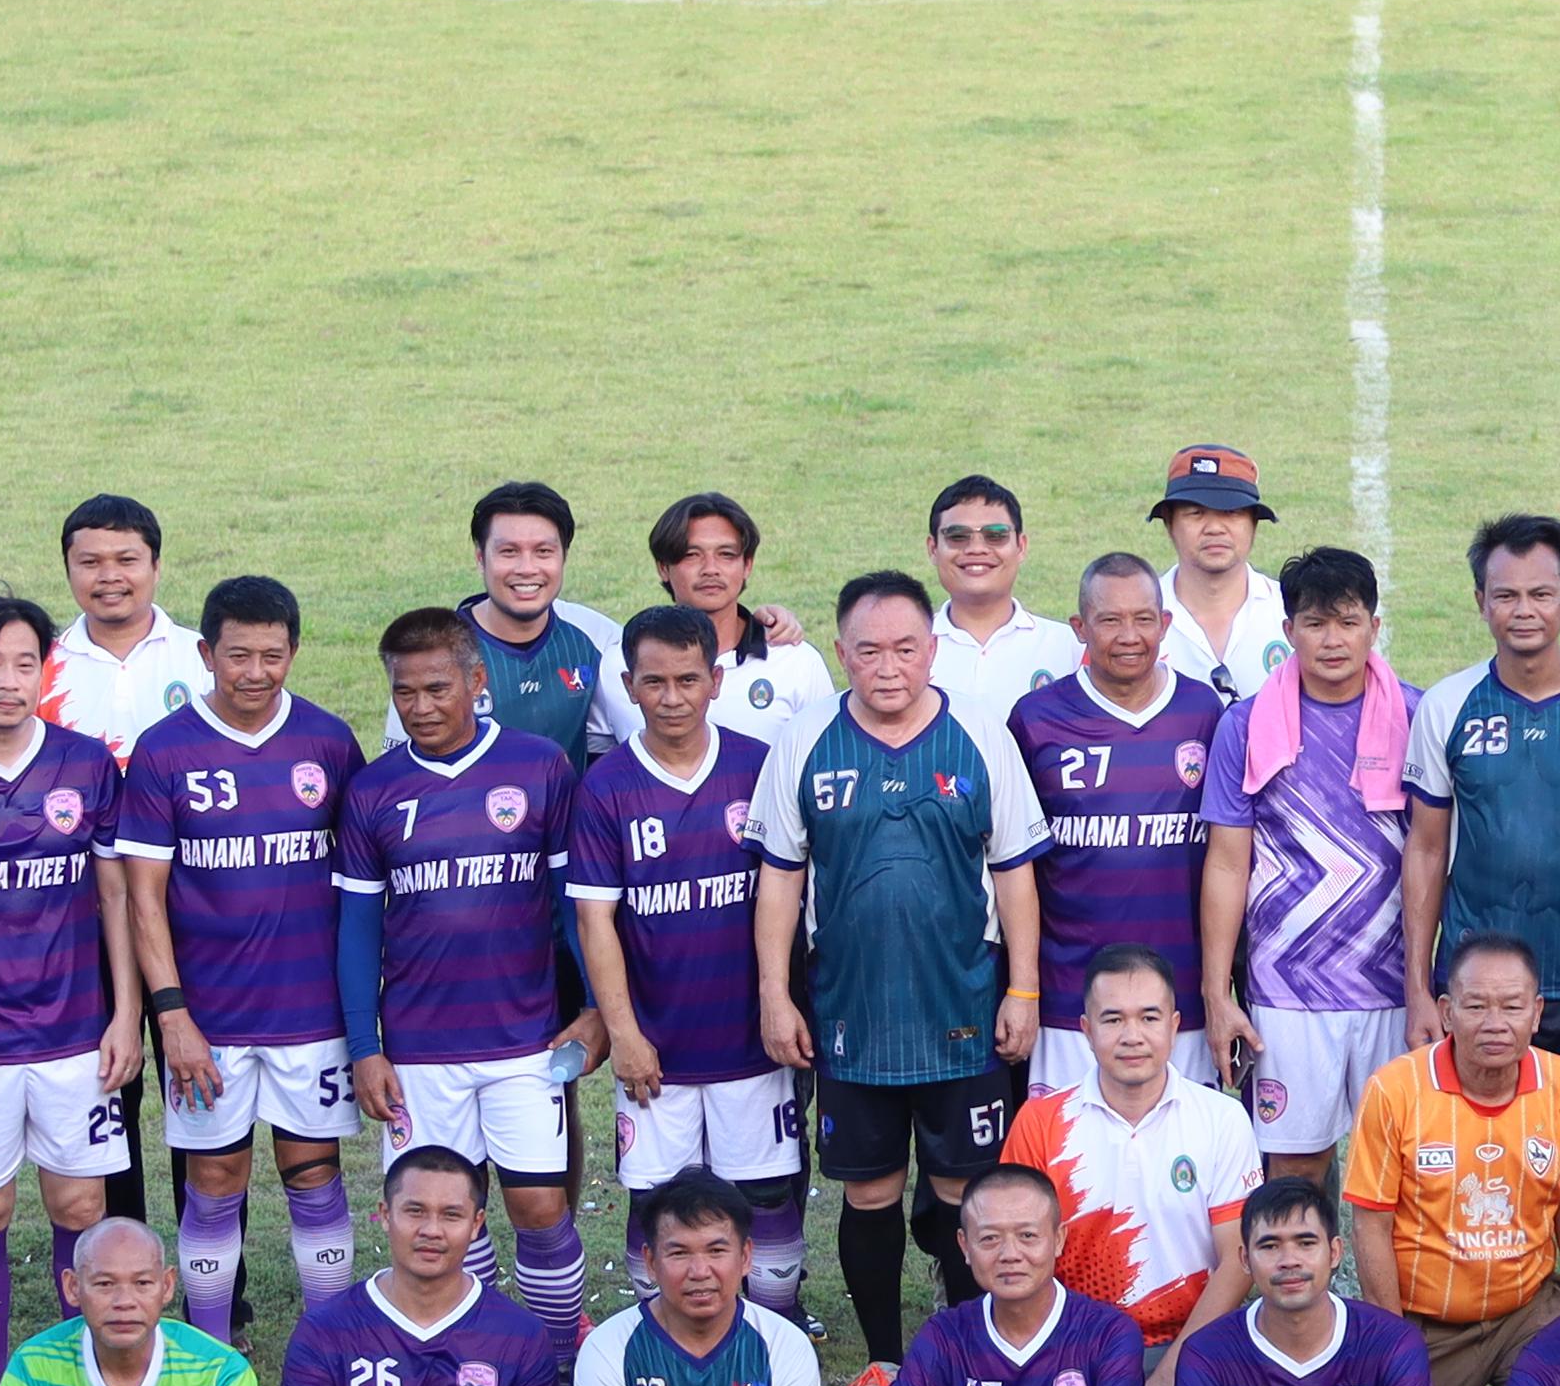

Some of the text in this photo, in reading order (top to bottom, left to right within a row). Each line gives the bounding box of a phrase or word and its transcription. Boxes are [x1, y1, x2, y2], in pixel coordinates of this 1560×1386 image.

[1461, 714, 1510, 757] 23
[1060, 744, 1113, 790] 27
[186, 769, 239, 814] 53
[813, 769, 859, 813] 57
[396, 798, 419, 842] 7
[629, 816, 667, 862] 18
[1137, 814, 1188, 846] TREE
[15, 854, 67, 890] TREE
[180, 835, 256, 871] BANANA
[262, 831, 312, 867] TREE
[456, 855, 504, 888] TREE
[626, 880, 692, 917] ANANA
[698, 872, 747, 911] TREE
[89, 1097, 127, 1146] 29
[969, 1099, 1005, 1147] 57
[1418, 1150, 1454, 1166] TOA
[1446, 1230, 1527, 1250] SINGHA
